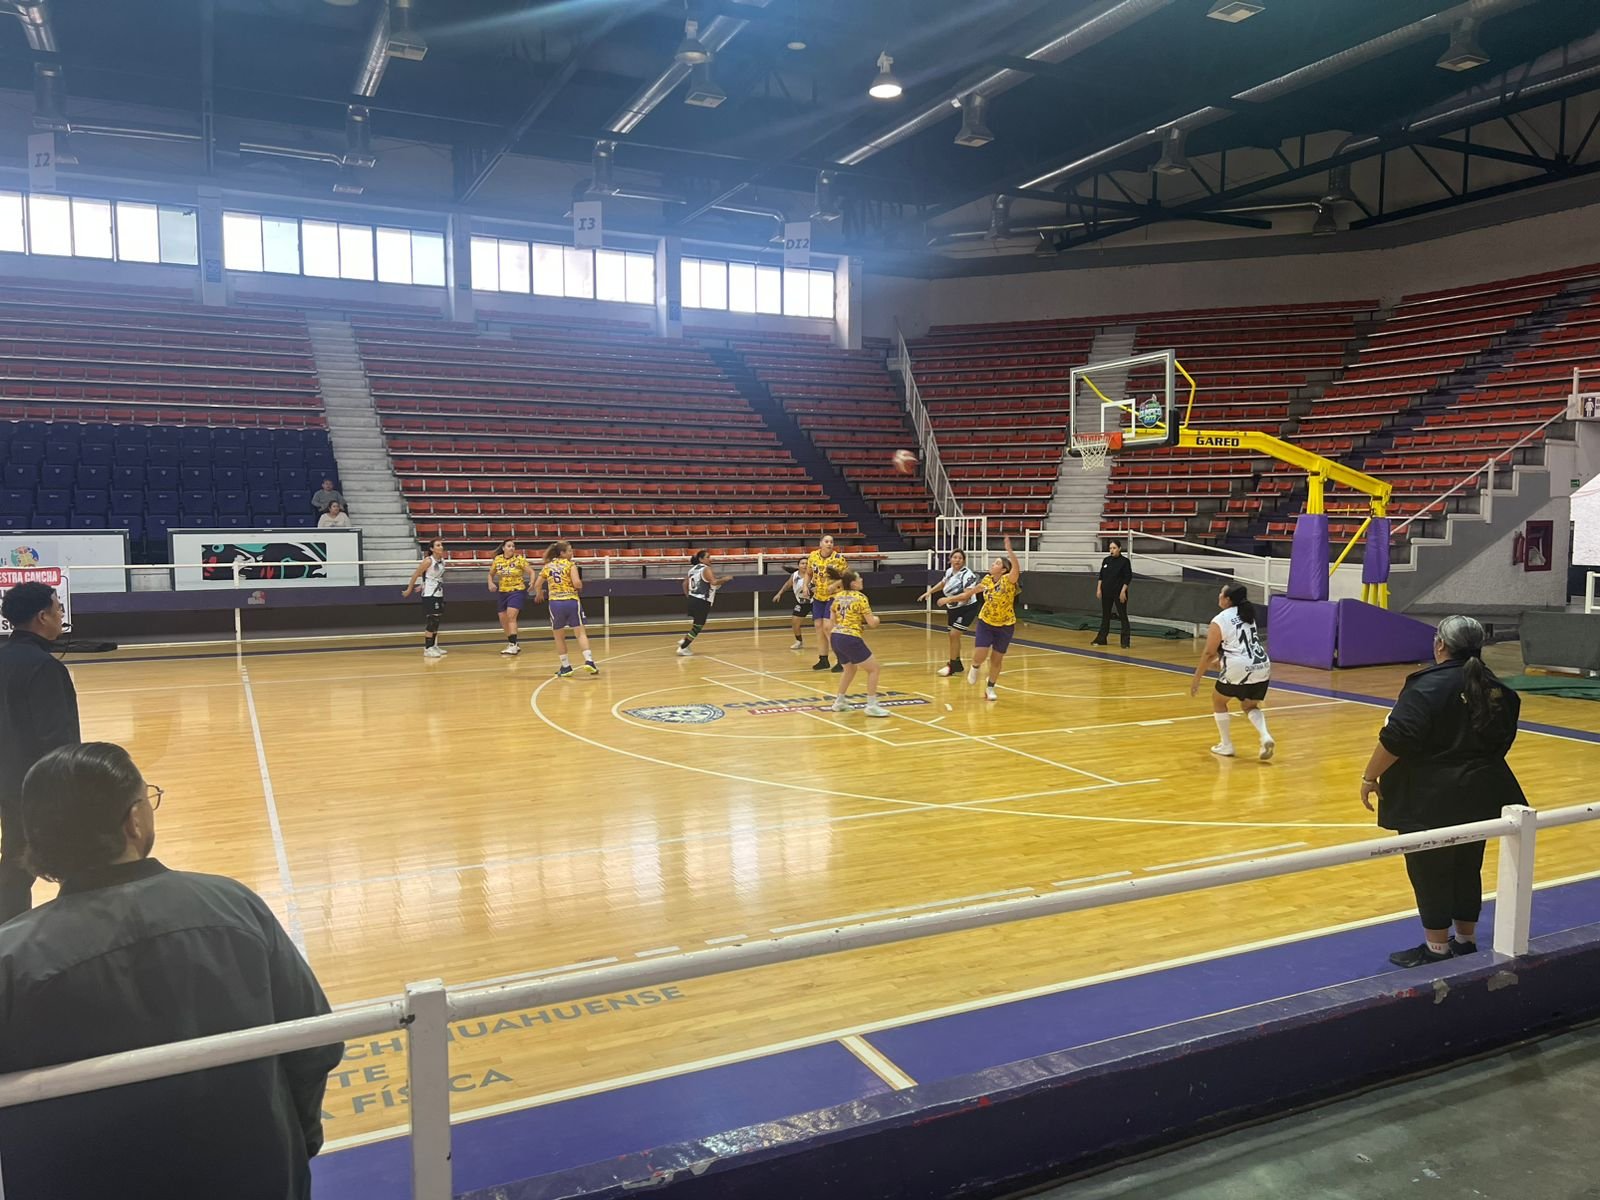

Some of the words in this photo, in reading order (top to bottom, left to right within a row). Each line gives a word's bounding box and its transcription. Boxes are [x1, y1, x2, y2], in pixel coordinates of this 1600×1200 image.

[1195, 436, 1240, 447] GARED
[24, 570, 58, 583] CANCHA
[342, 986, 686, 1061] CHUAHUENSE
